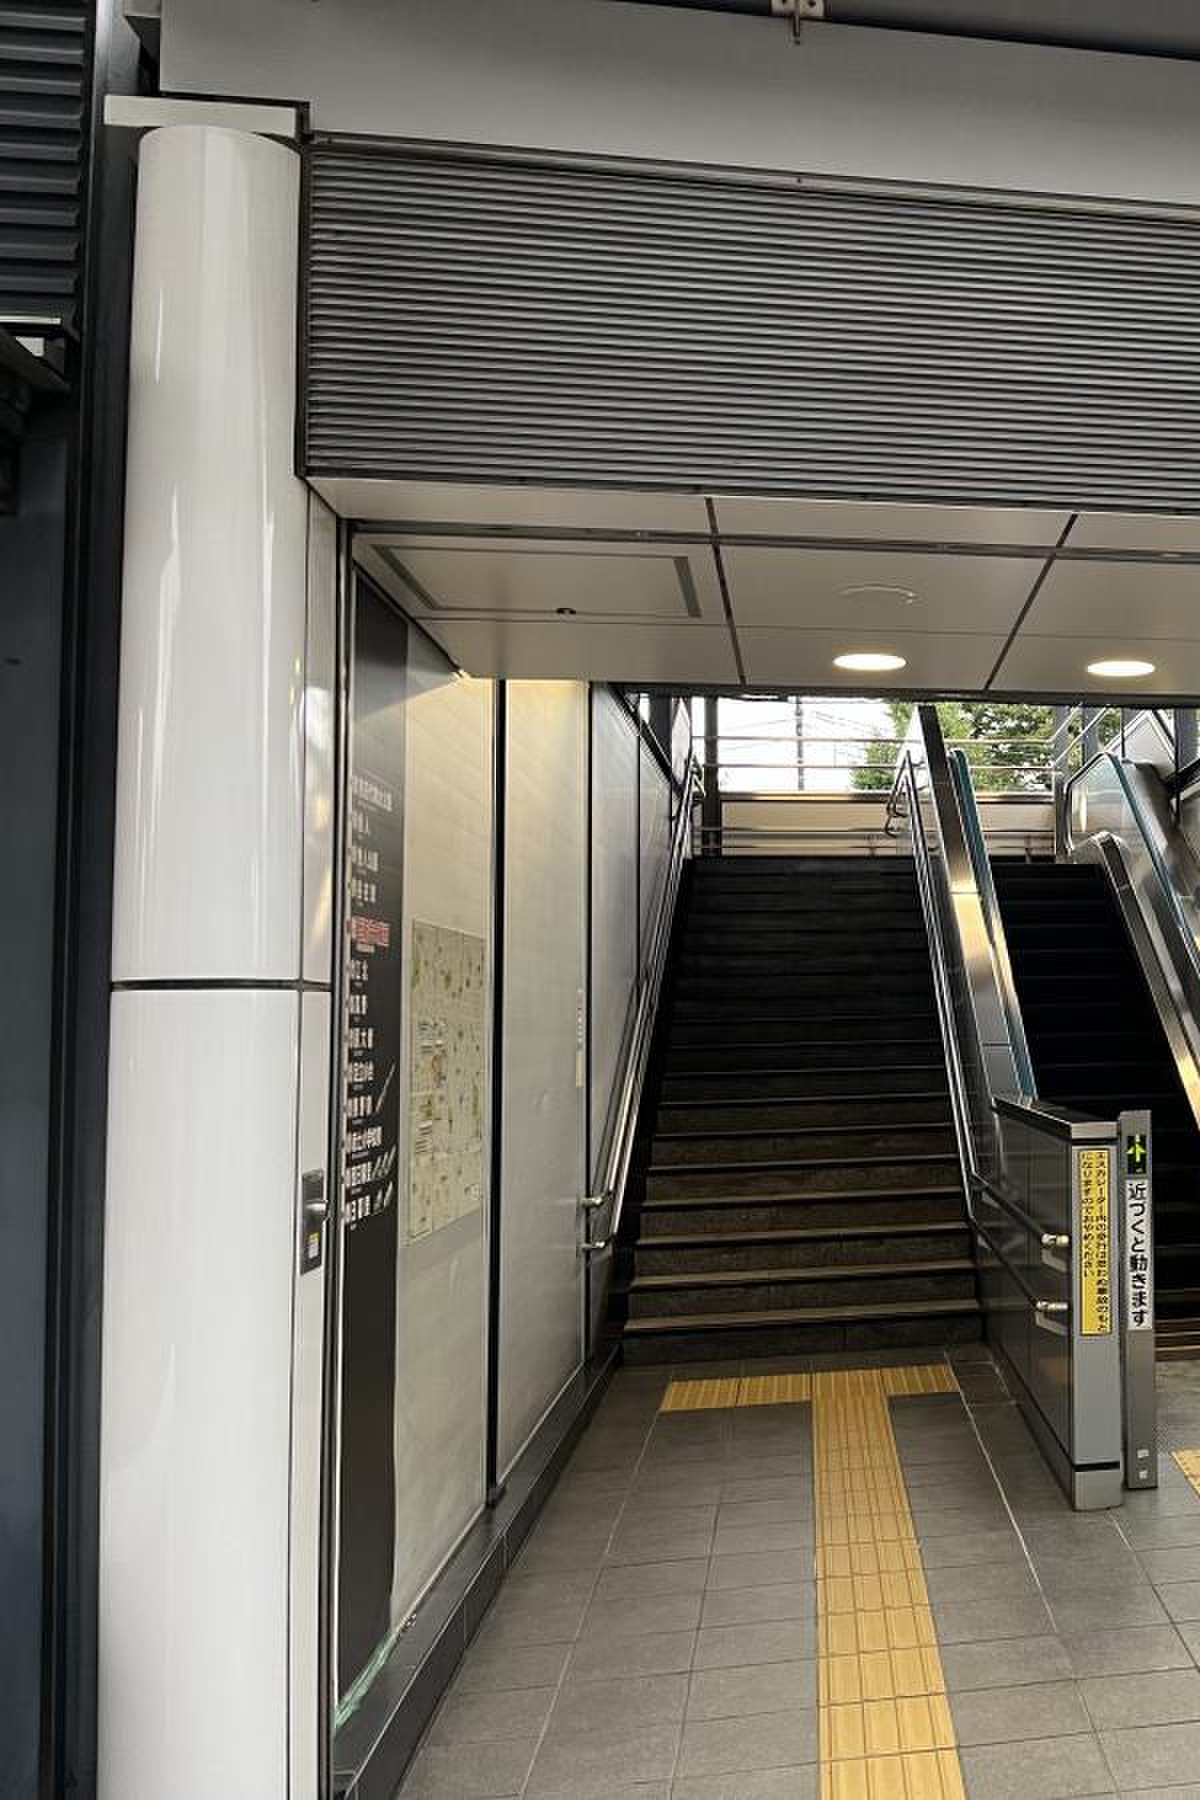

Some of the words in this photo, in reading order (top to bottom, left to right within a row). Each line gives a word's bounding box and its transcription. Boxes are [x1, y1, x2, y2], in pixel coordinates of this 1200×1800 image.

[1128, 1182, 1149, 1327] 近づくと動きます
